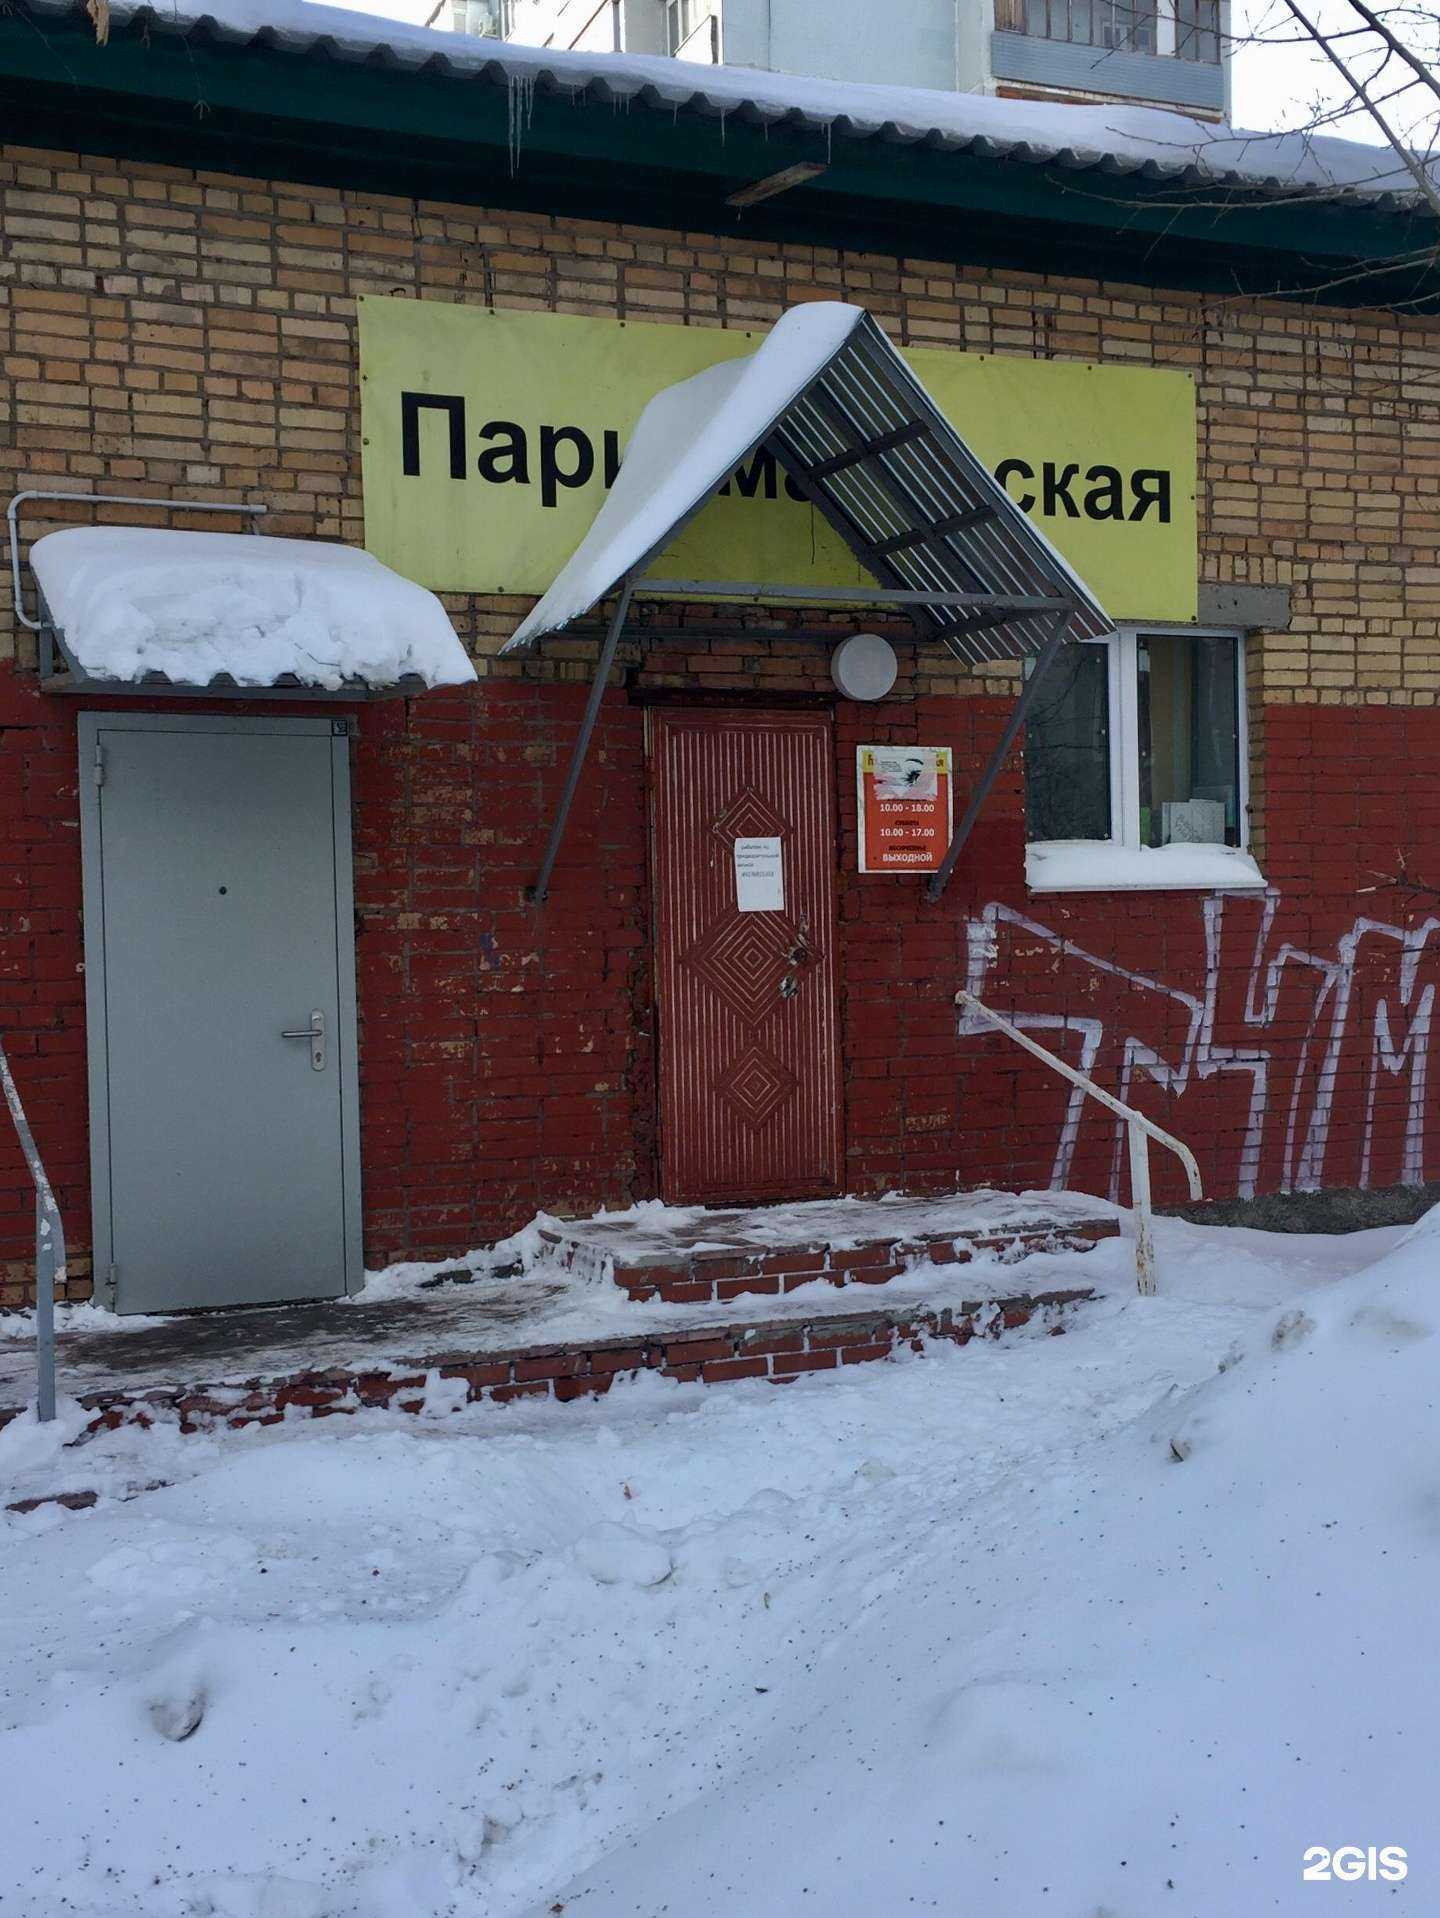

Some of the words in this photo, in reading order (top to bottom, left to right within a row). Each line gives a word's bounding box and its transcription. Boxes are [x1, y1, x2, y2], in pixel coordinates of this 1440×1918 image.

[880, 803, 904, 812] 10.00
[911, 803, 935, 812] 18.00
[880, 828, 904, 837] 10.00
[911, 828, 935, 837] 17.00
[882, 852, 933, 864] ВЫХОДНОЙ
